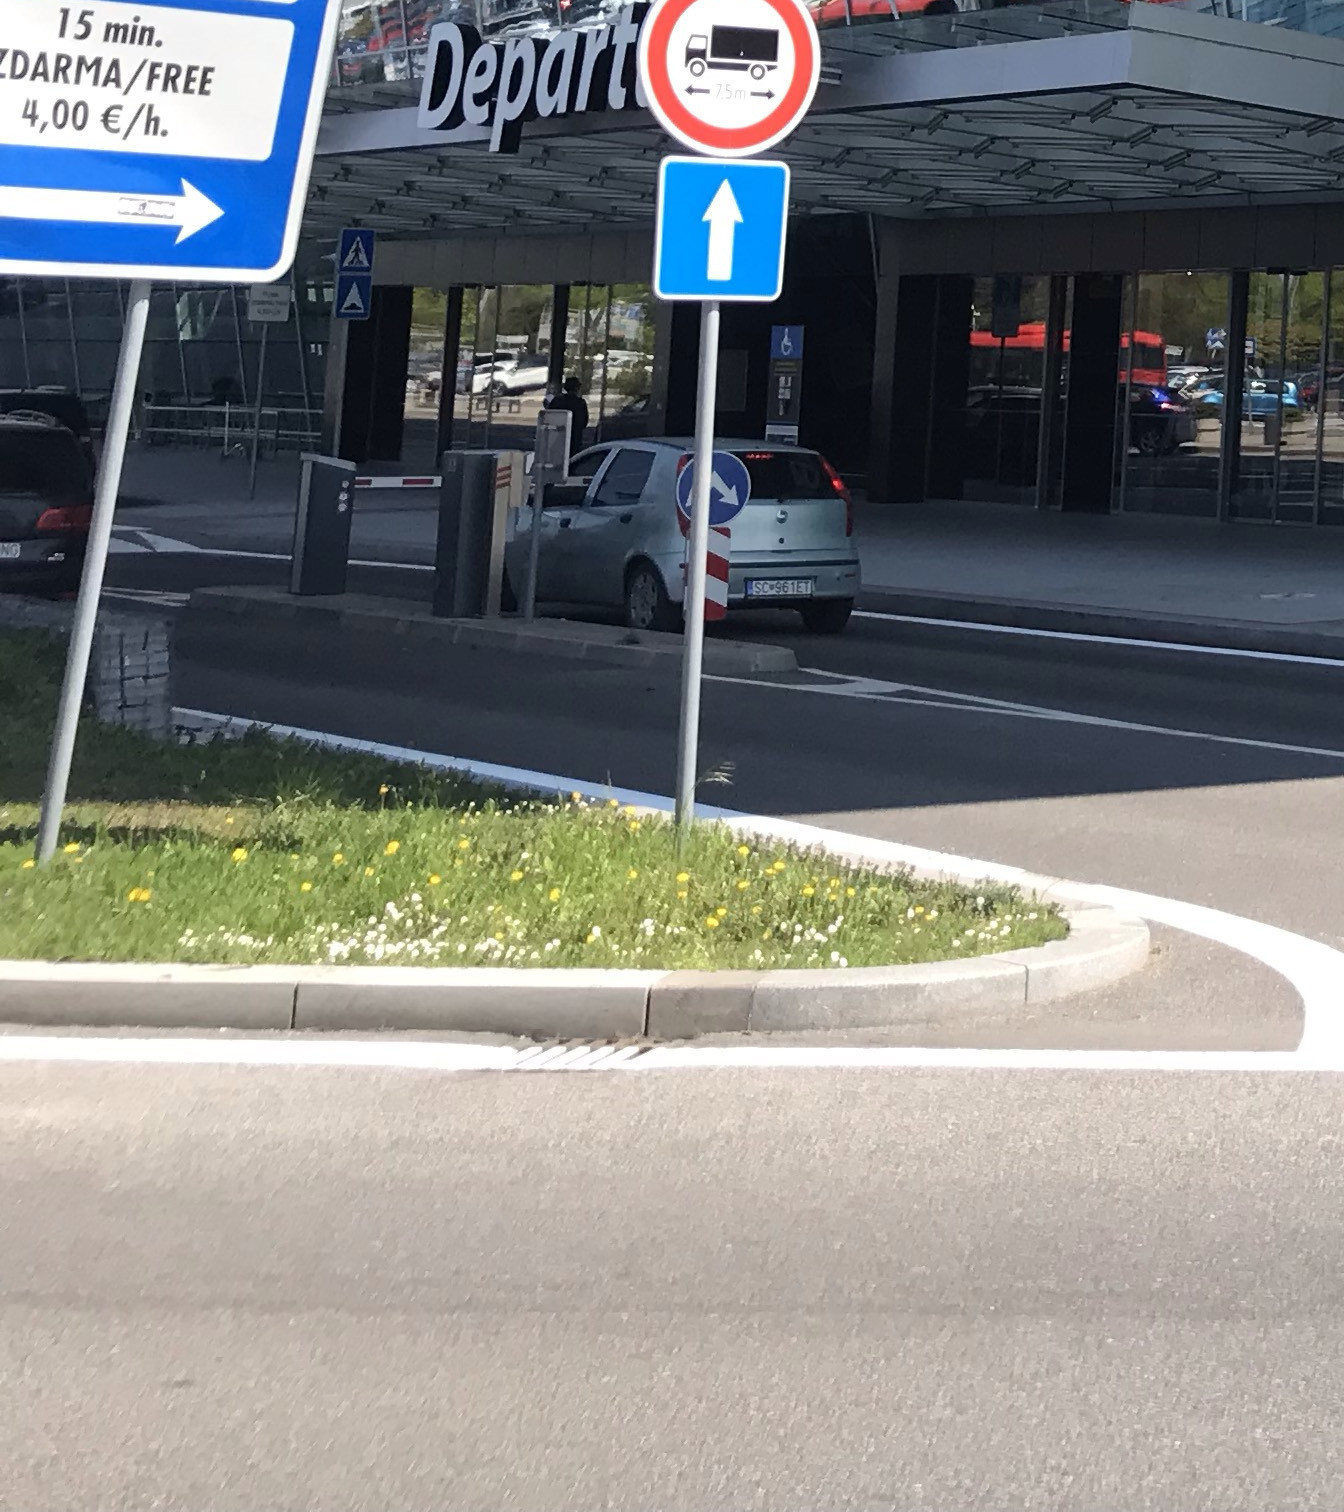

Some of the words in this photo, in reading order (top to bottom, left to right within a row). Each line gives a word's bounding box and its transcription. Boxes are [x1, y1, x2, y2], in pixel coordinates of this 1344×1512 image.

[58, 7, 95, 40] 15
[102, 15, 163, 48] min.
[416, 3, 650, 152] Depart
[21, 97, 89, 134] 4,00
[100, 102, 169, 140] €/h.
